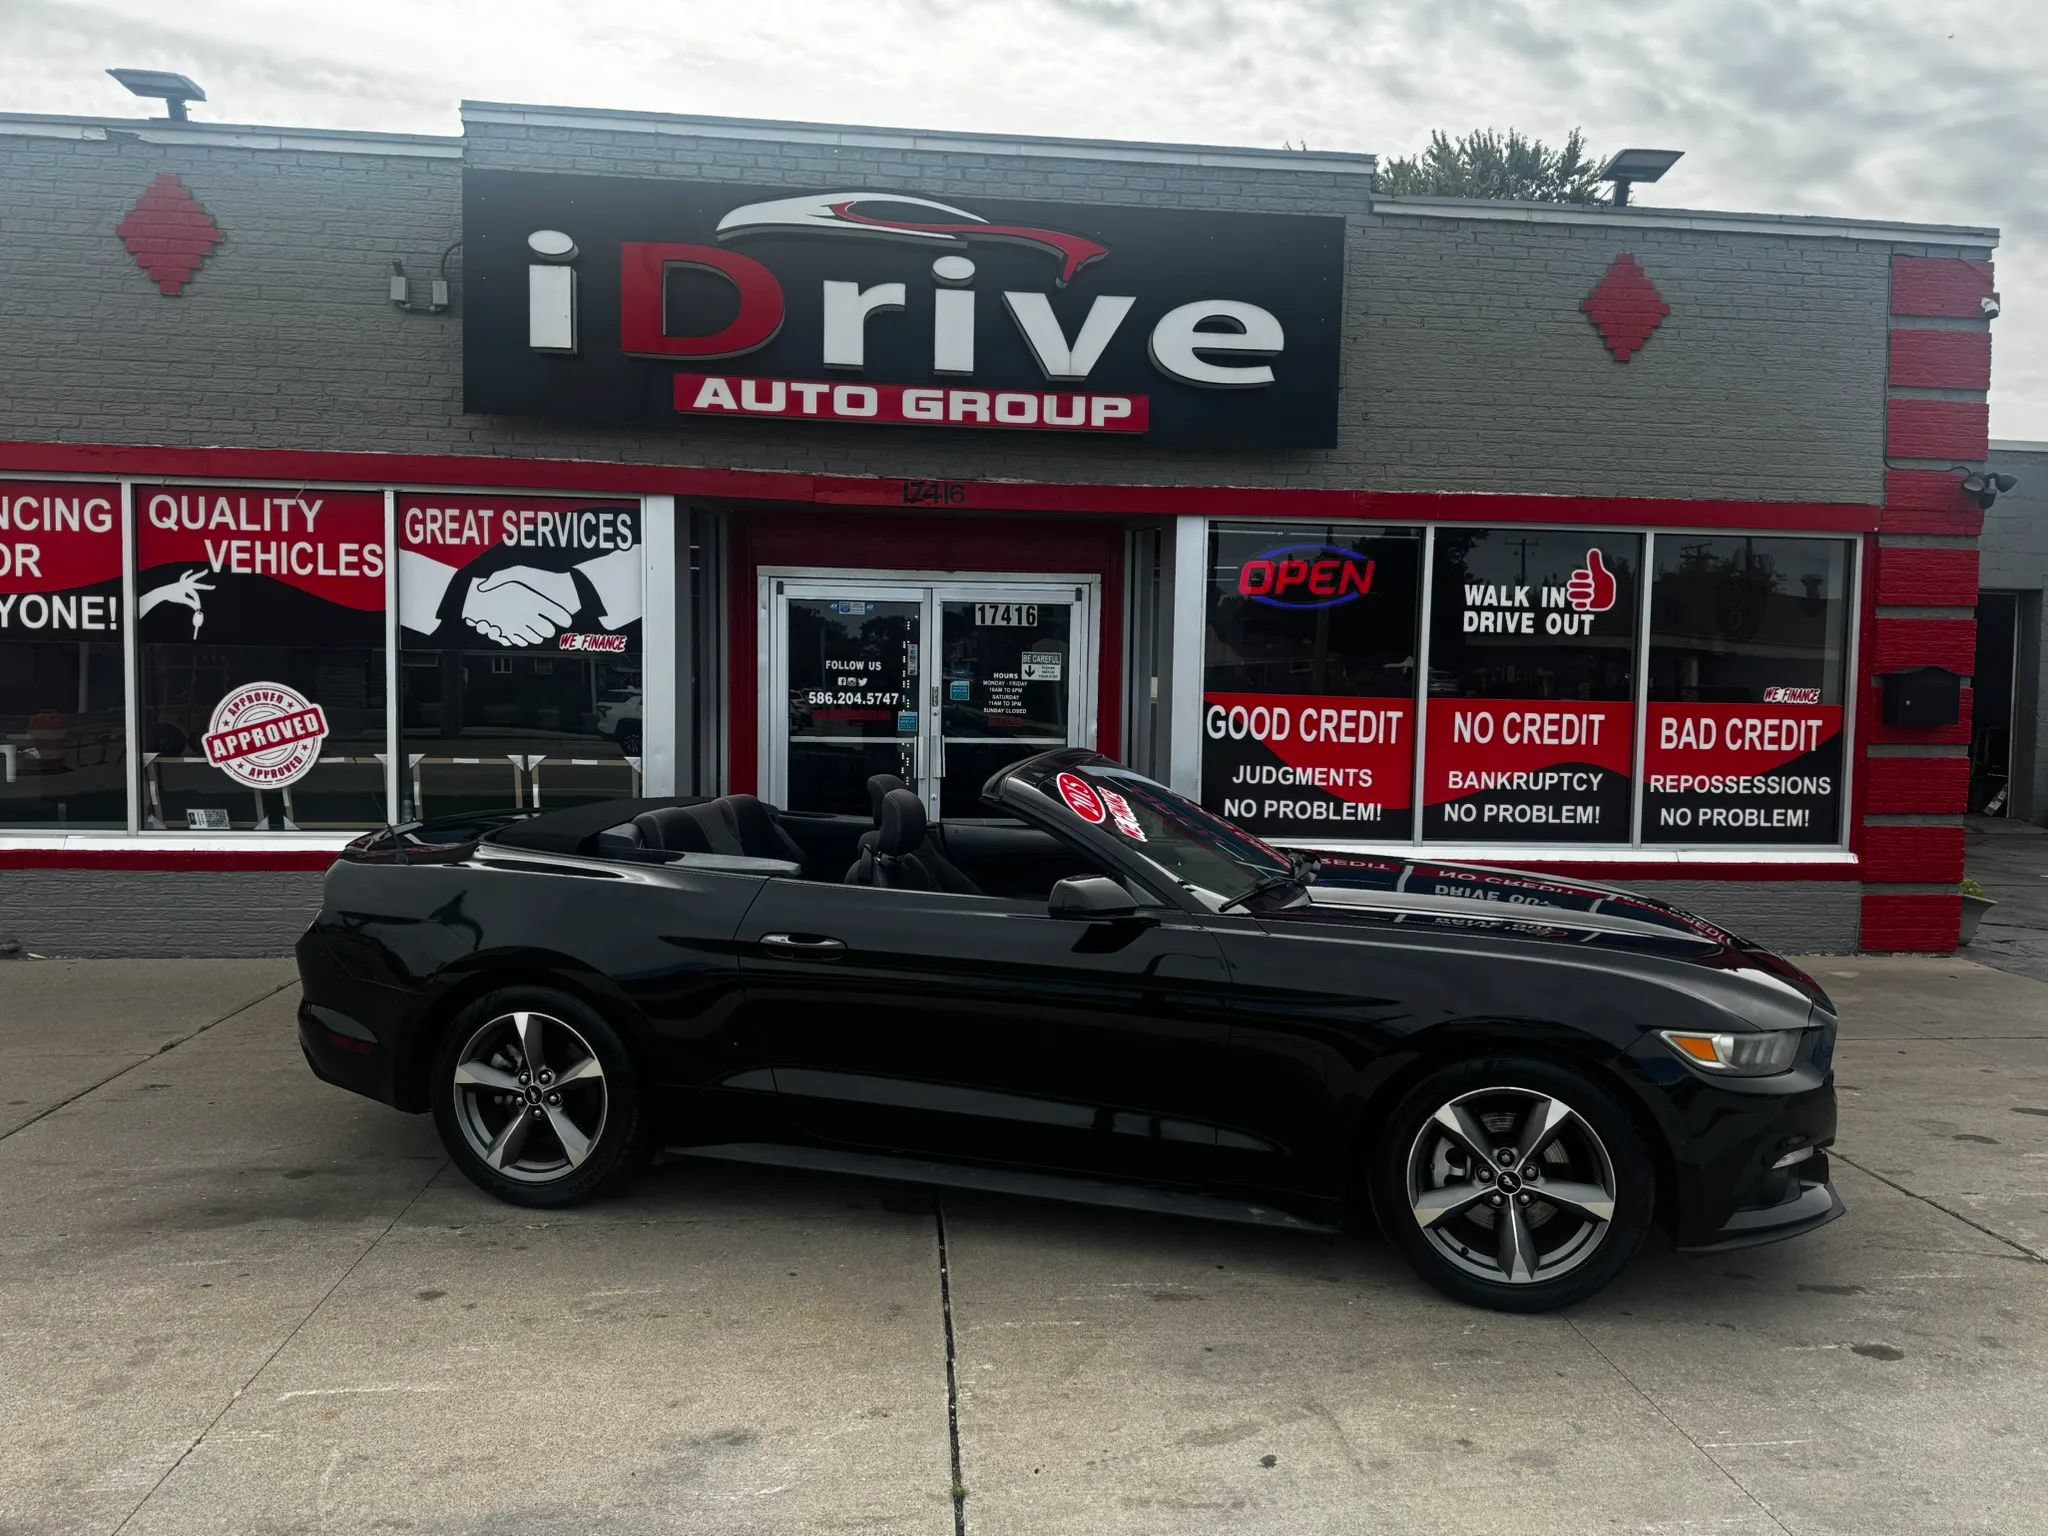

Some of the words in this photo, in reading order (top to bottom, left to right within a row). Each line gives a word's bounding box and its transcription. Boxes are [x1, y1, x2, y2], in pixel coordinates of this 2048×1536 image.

[528, 230, 1285, 388] iDrive
[692, 377, 878, 417] AUTO
[901, 388, 1132, 427] GROUP
[903, 480, 966, 505] 17416
[148, 494, 324, 533] QUALITY
[404, 507, 494, 546] GREAT
[502, 509, 633, 551] SERVICES
[204, 539, 384, 578] VEHICLES
[1238, 559, 1377, 597] OPEN
[1464, 584, 1531, 608] WALK
[1541, 586, 1566, 608] IN
[977, 604, 1037, 626] 17416
[1463, 610, 1535, 634] DRIVE
[1545, 612, 1595, 636] OUT
[560, 633, 578, 650] WE
[581, 633, 627, 653] FINANCE
[825, 660, 865, 671] FOLLOW
[868, 661, 882, 671] US
[1023, 654, 1033, 663] BE
[1033, 654, 1060, 664] CAREFUL
[228, 691, 285, 718] APPROVED
[808, 691, 900, 705] 586.204.5747
[1764, 687, 1779, 702] WE
[1781, 687, 1820, 704] FINANCE
[213, 713, 320, 759] APPROVED
[1206, 705, 1291, 741] GOOD
[1300, 708, 1404, 744] CREDIT
[1453, 711, 1495, 744] NO
[1503, 711, 1606, 746] CREDIT
[1660, 717, 1717, 750] BAD
[1725, 718, 1823, 752] CREDIT
[248, 755, 304, 779] APPROVED
[1232, 765, 1373, 788] JUDGMENTS
[1448, 770, 1604, 792] BANKRUPTCY
[1650, 774, 1832, 795] REPOSSESSIONS
[1224, 798, 1257, 818] NO
[1264, 800, 1381, 821] PROBLEM!
[1444, 803, 1477, 823] NO
[1483, 804, 1600, 824] PROBLEM!
[1660, 808, 1692, 826] NO
[1698, 808, 1811, 828] PROBLEM!
